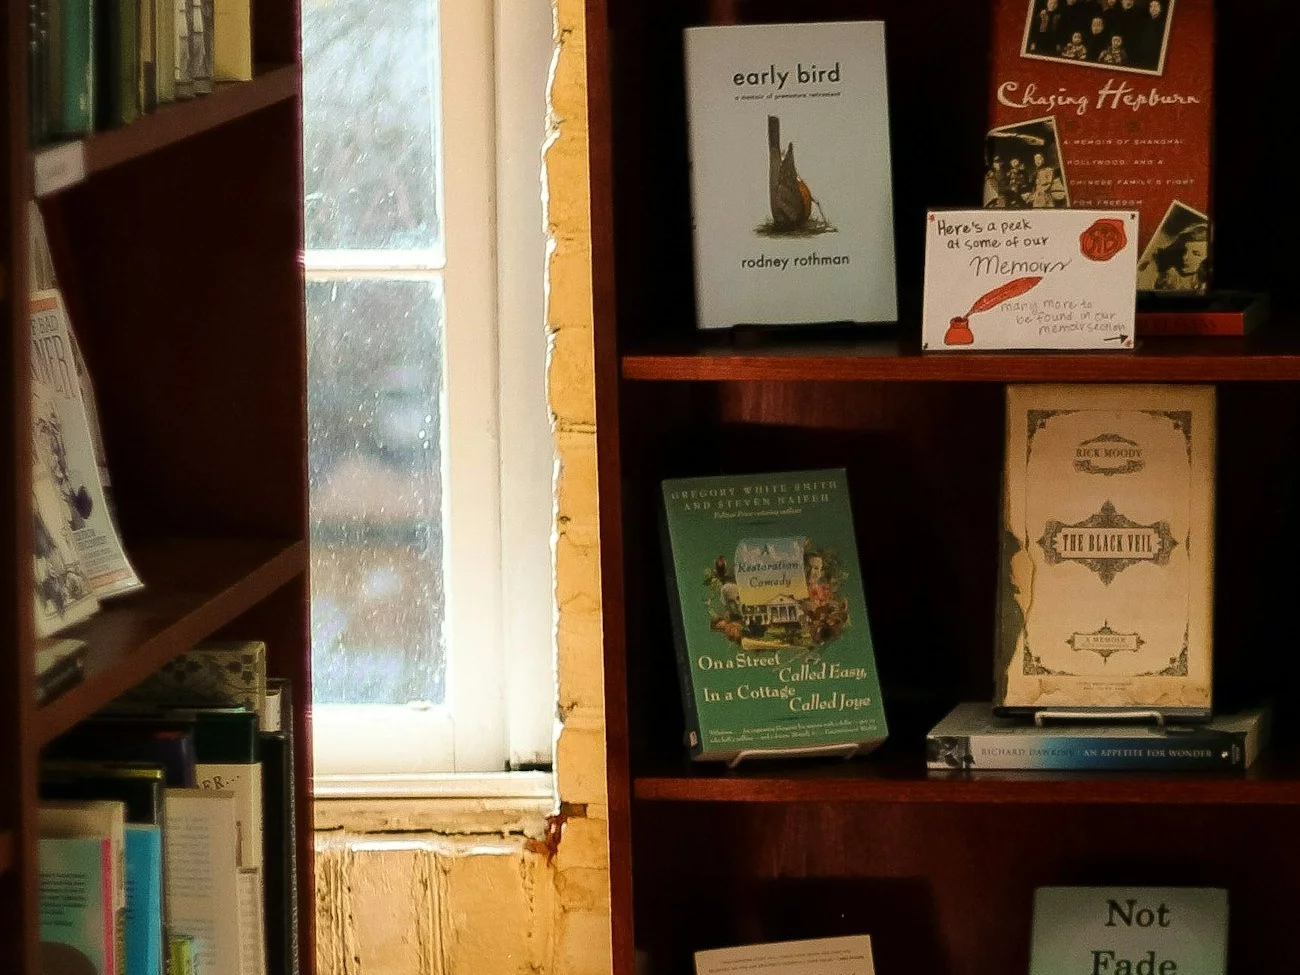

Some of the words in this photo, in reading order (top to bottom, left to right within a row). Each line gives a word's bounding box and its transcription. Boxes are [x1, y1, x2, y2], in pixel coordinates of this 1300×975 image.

[733, 64, 789, 90] early
[797, 62, 840, 84] bird
[997, 81, 1088, 115] Chasing
[1096, 79, 1200, 111] Hepburn
[937, 219, 983, 236] Here's
[987, 222, 997, 231] a
[1001, 218, 1032, 235] peek
[947, 238, 960, 249] at
[965, 239, 1001, 250] some
[1005, 236, 1019, 247] of
[1023, 235, 1049, 247] our
[742, 254, 789, 270] rodney
[794, 253, 850, 267] rothman
[969, 254, 1072, 277] Memoirs
[1042, 299, 1077, 310] more
[1016, 314, 1032, 325] be
[1035, 311, 1073, 323] found
[1076, 448, 1099, 458] RICK
[1103, 448, 1142, 458] MOODY
[684, 501, 711, 511] AND
[1063, 534, 1084, 552] THE
[1089, 534, 1123, 552] BLACK
[1128, 534, 1153, 552] VEIL
[737, 560, 799, 573] Restoration
[698, 655, 723, 671] On
[726, 660, 734, 669] a
[736, 652, 781, 668] Street
[779, 663, 827, 683] Called
[829, 663, 867, 681] Easy,
[704, 687, 721, 702] In
[725, 692, 734, 701] a
[737, 684, 796, 700] Cottage
[789, 691, 837, 712] Called
[981, 747, 1026, 757] RICHARD
[1147, 748, 1167, 758] FOR
[1105, 899, 1170, 928] Not
